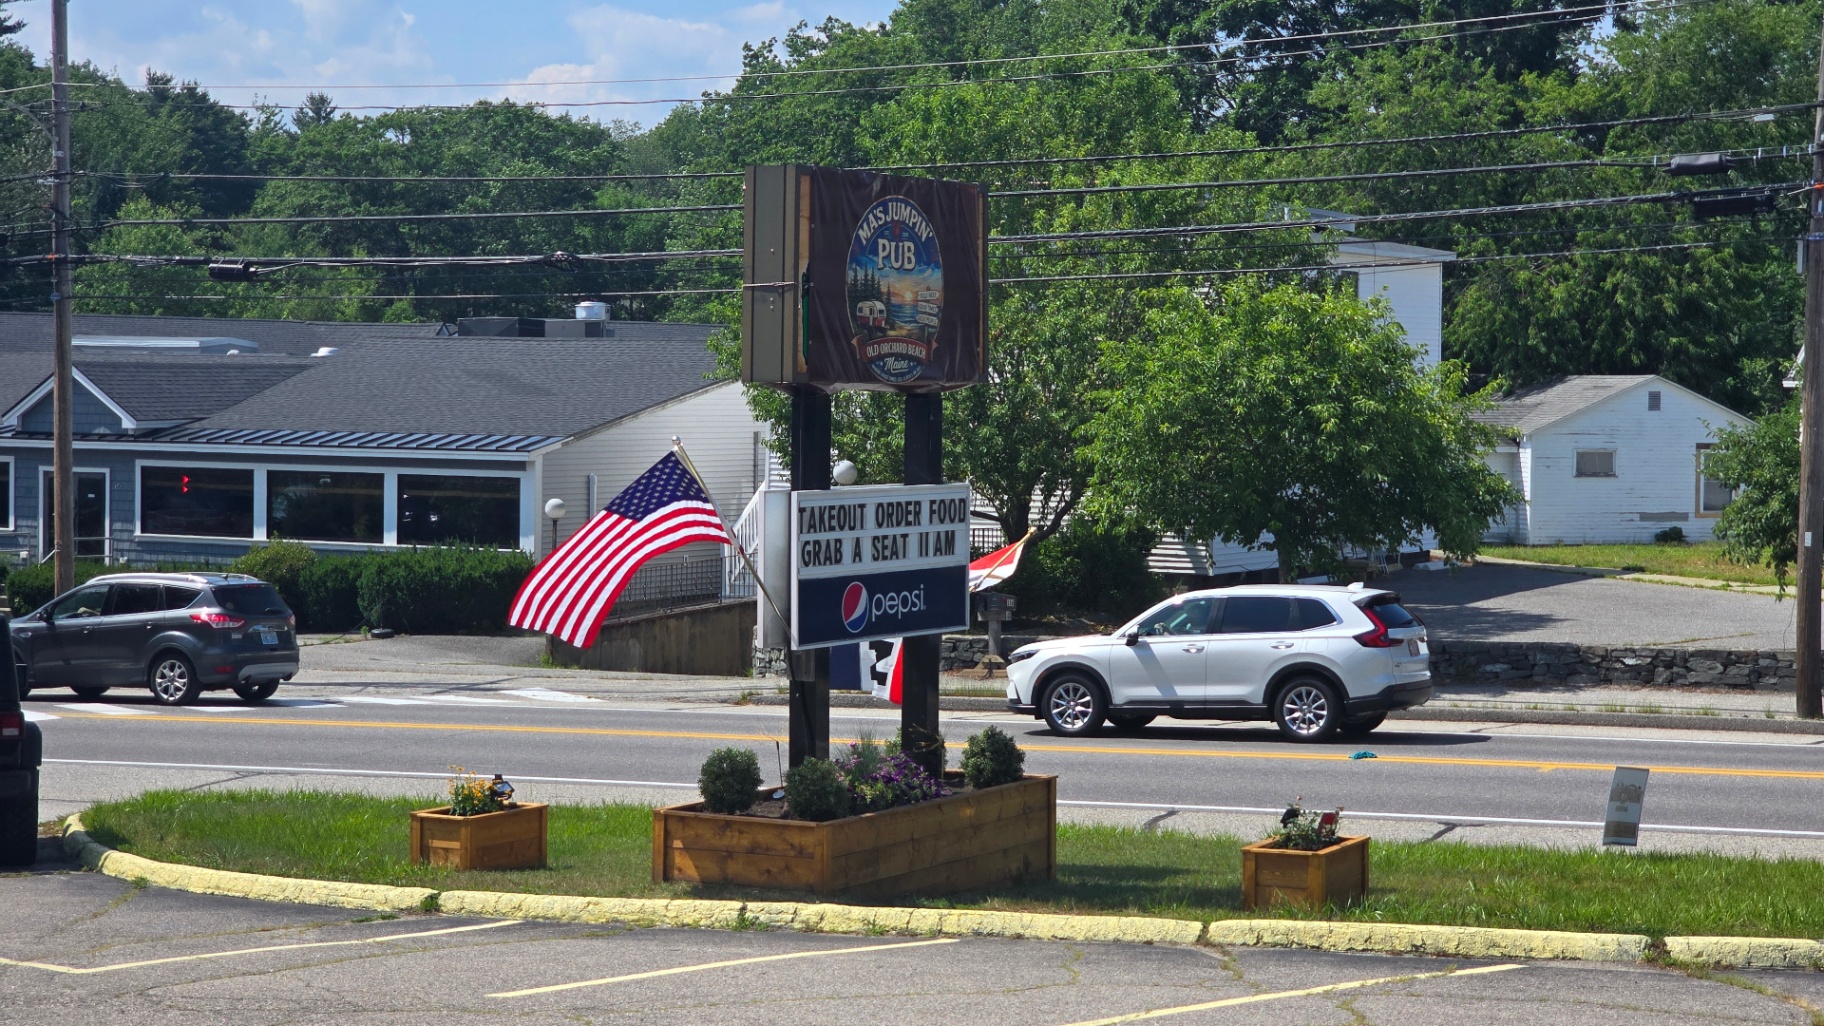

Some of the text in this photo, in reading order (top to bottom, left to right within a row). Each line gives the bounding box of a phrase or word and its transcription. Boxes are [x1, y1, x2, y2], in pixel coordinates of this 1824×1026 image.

[858, 202, 933, 246] MA'S JUMPIN'
[878, 238, 916, 270] PUB
[866, 342, 926, 359] OLD ORCHARD BEACH
[884, 356, 909, 374] Maine
[798, 498, 966, 534] TAKEOUT ORDER FOOD
[801, 538, 843, 568] GRAB
[853, 537, 862, 563] A
[872, 534, 909, 562] SEAT
[872, 584, 924, 622] pepsi
